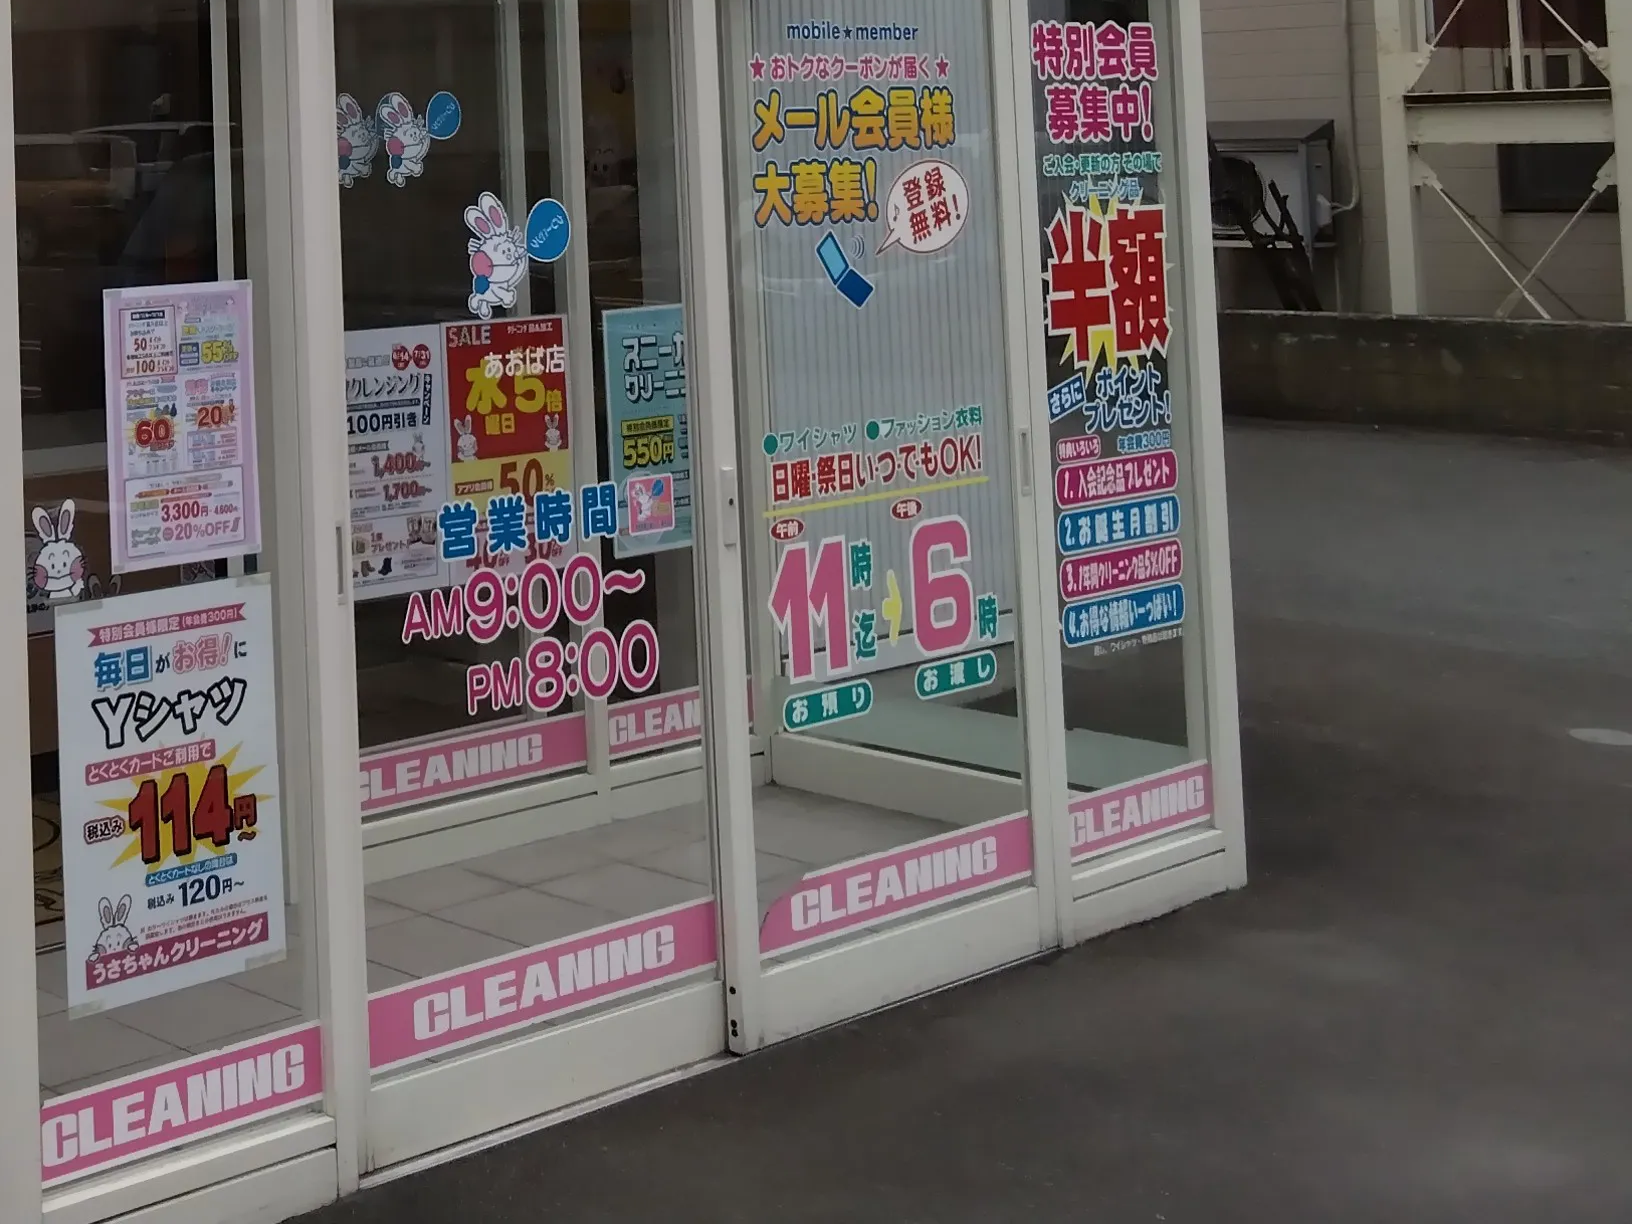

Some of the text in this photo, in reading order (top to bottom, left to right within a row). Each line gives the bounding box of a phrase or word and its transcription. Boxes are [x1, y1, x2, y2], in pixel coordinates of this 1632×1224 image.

[770, 54, 931, 81] おトクなクーポンが届く
[1031, 19, 1159, 81] 特別会員
[751, 84, 957, 152] メール会員様
[1044, 80, 1154, 144] 募集中!
[751, 156, 880, 229] 大募集!
[1043, 204, 1172, 370] 半額
[448, 325, 492, 348] SALE
[484, 343, 566, 378] あおば店
[1049, 378, 1084, 414] さらに
[1082, 388, 1173, 434] プレゼント!
[1095, 362, 1162, 399] ポイント
[623, 434, 674, 468] 550円
[779, 405, 983, 453] ワイシャツ ファッション衣料
[439, 483, 618, 561] 営業時間
[768, 535, 852, 684] 11
[909, 514, 973, 657] 6
[977, 592, 999, 641] 時
[91, 675, 248, 750] Yシャツ
[87, 743, 213, 784] とくとくカードご利用で
[1069, 776, 1205, 848] CLEANING
[790, 835, 998, 932] CLEANING
[93, 918, 263, 984] うさちゃんクリーニング
[413, 924, 675, 1041] CLEANING
[42, 1043, 305, 1168] CLEANING
